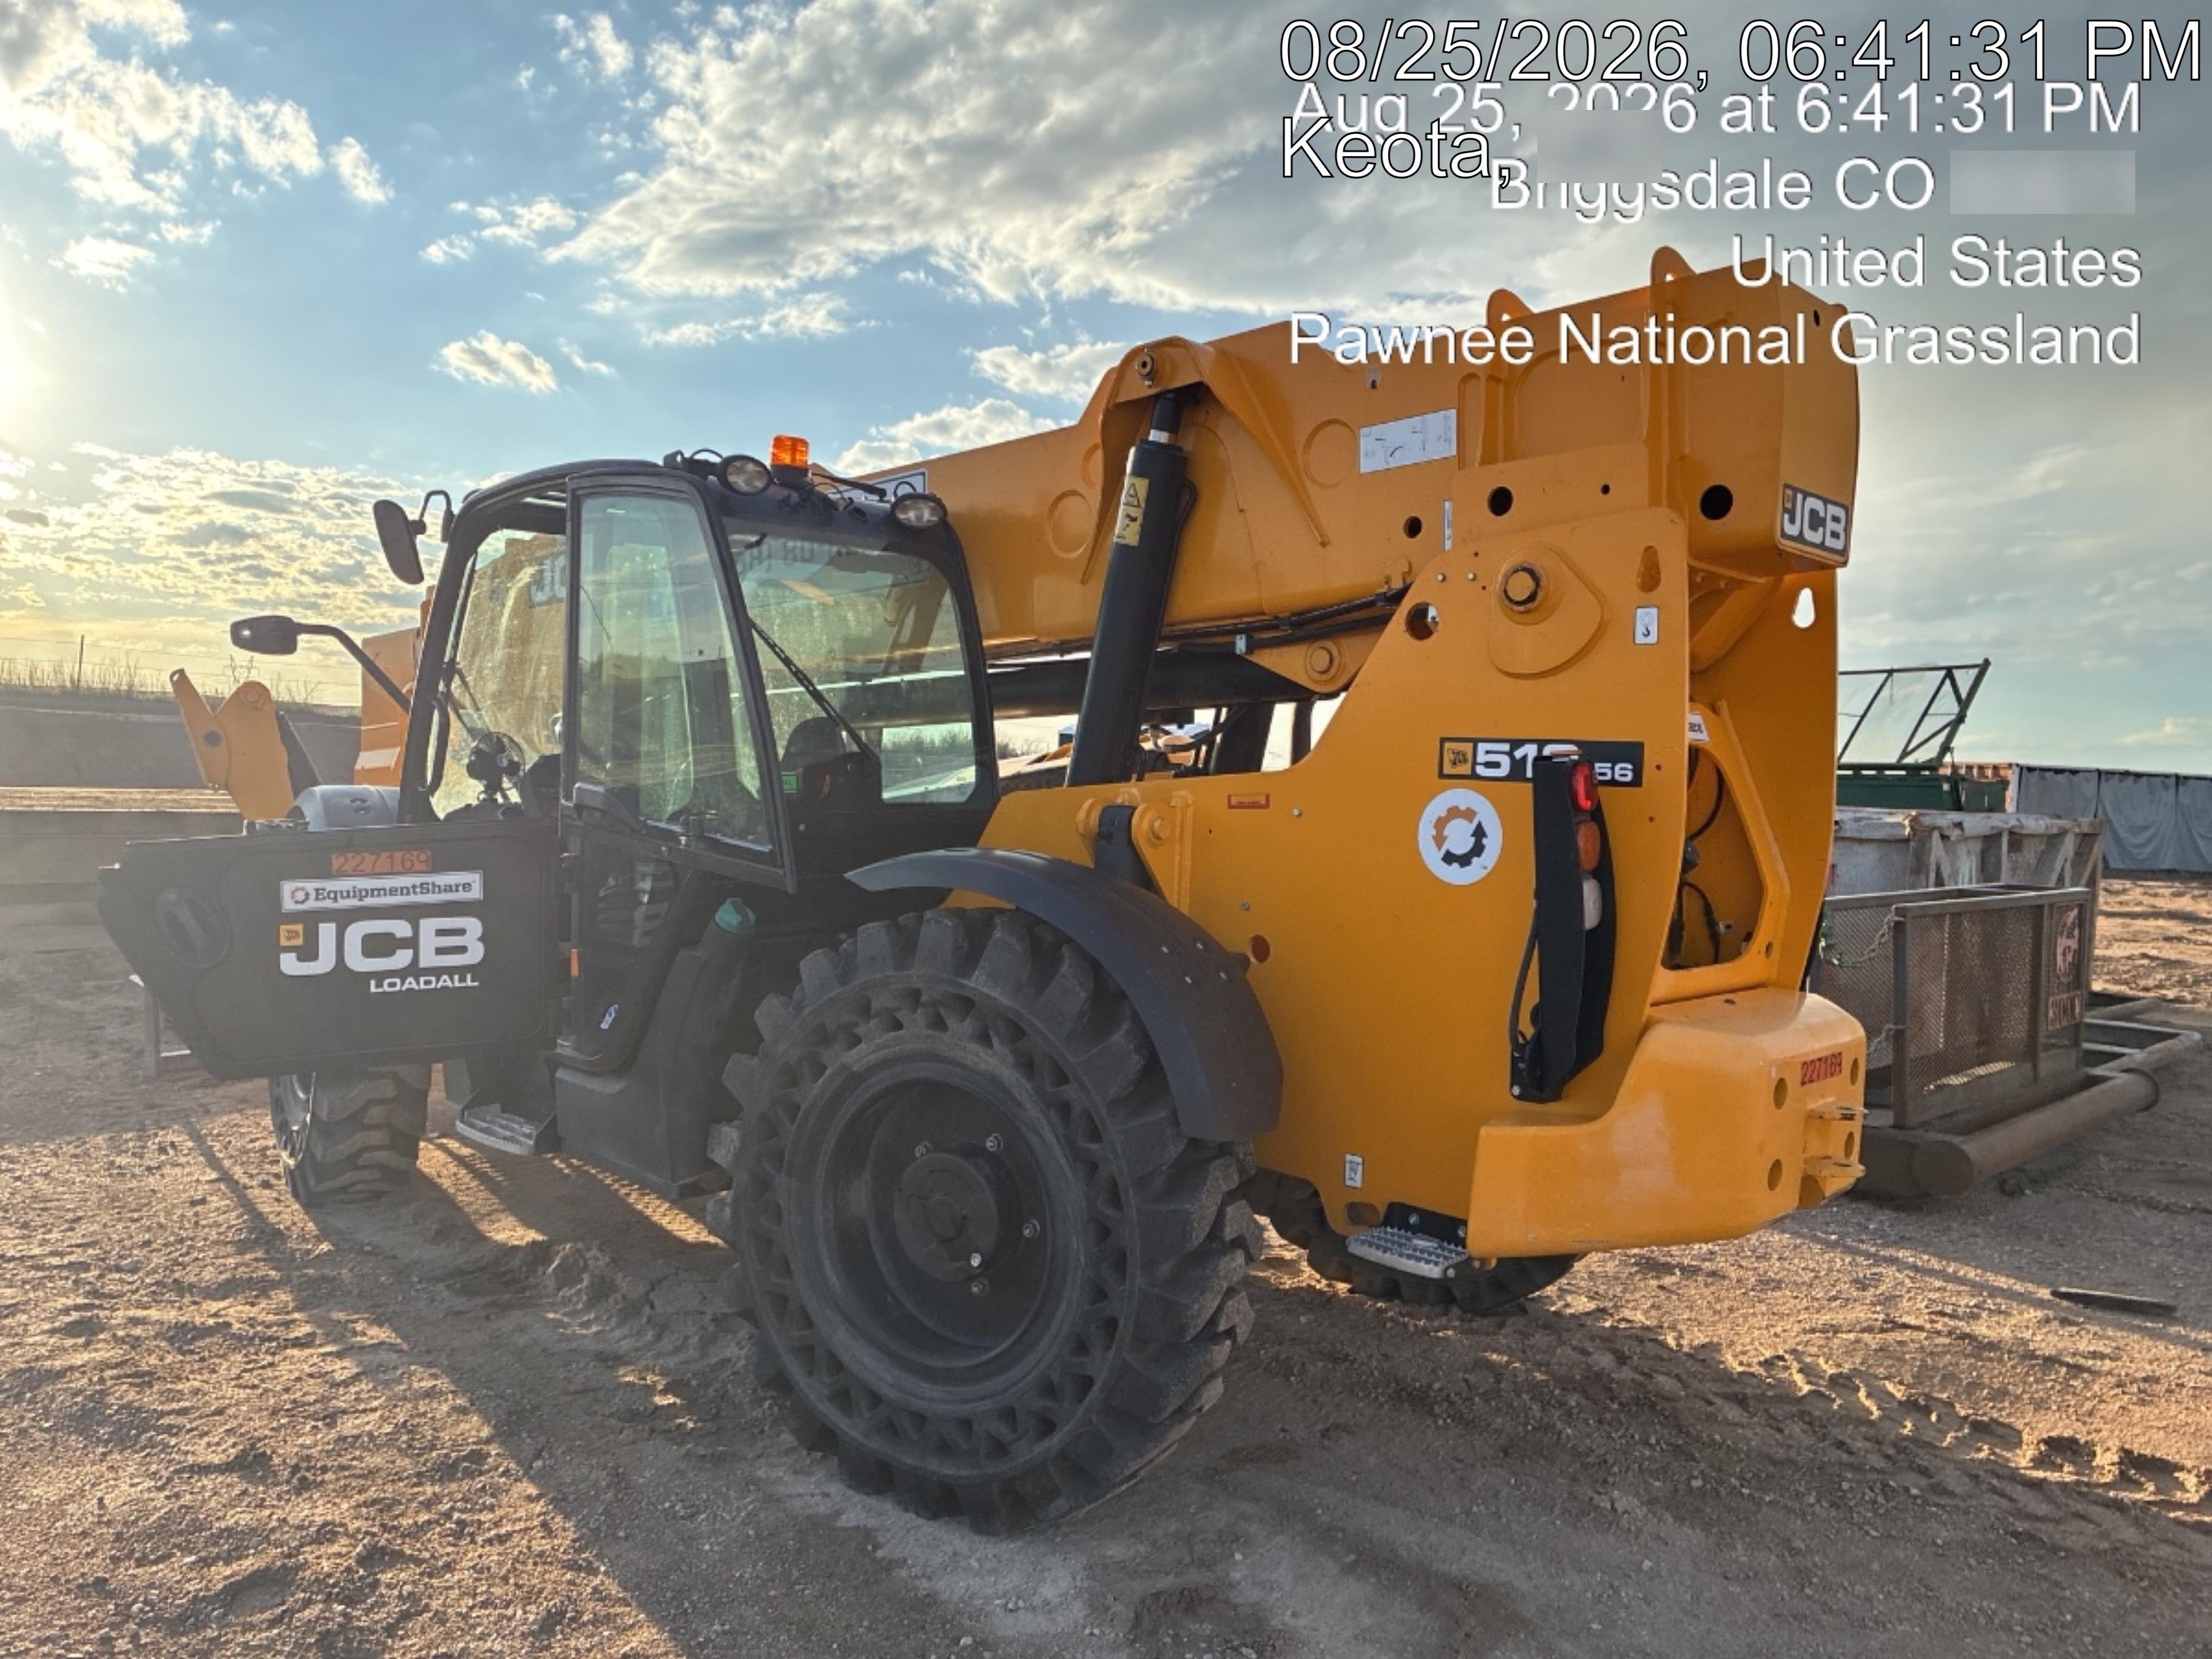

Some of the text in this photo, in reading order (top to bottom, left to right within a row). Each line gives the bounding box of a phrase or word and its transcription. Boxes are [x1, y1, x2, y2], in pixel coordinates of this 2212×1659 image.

[1784, 492, 1846, 551] JCB
[335, 851, 428, 873] 227169
[313, 881, 473, 903] EquipmentShare
[280, 917, 485, 976] JCB
[370, 973, 479, 993] LOADALL
